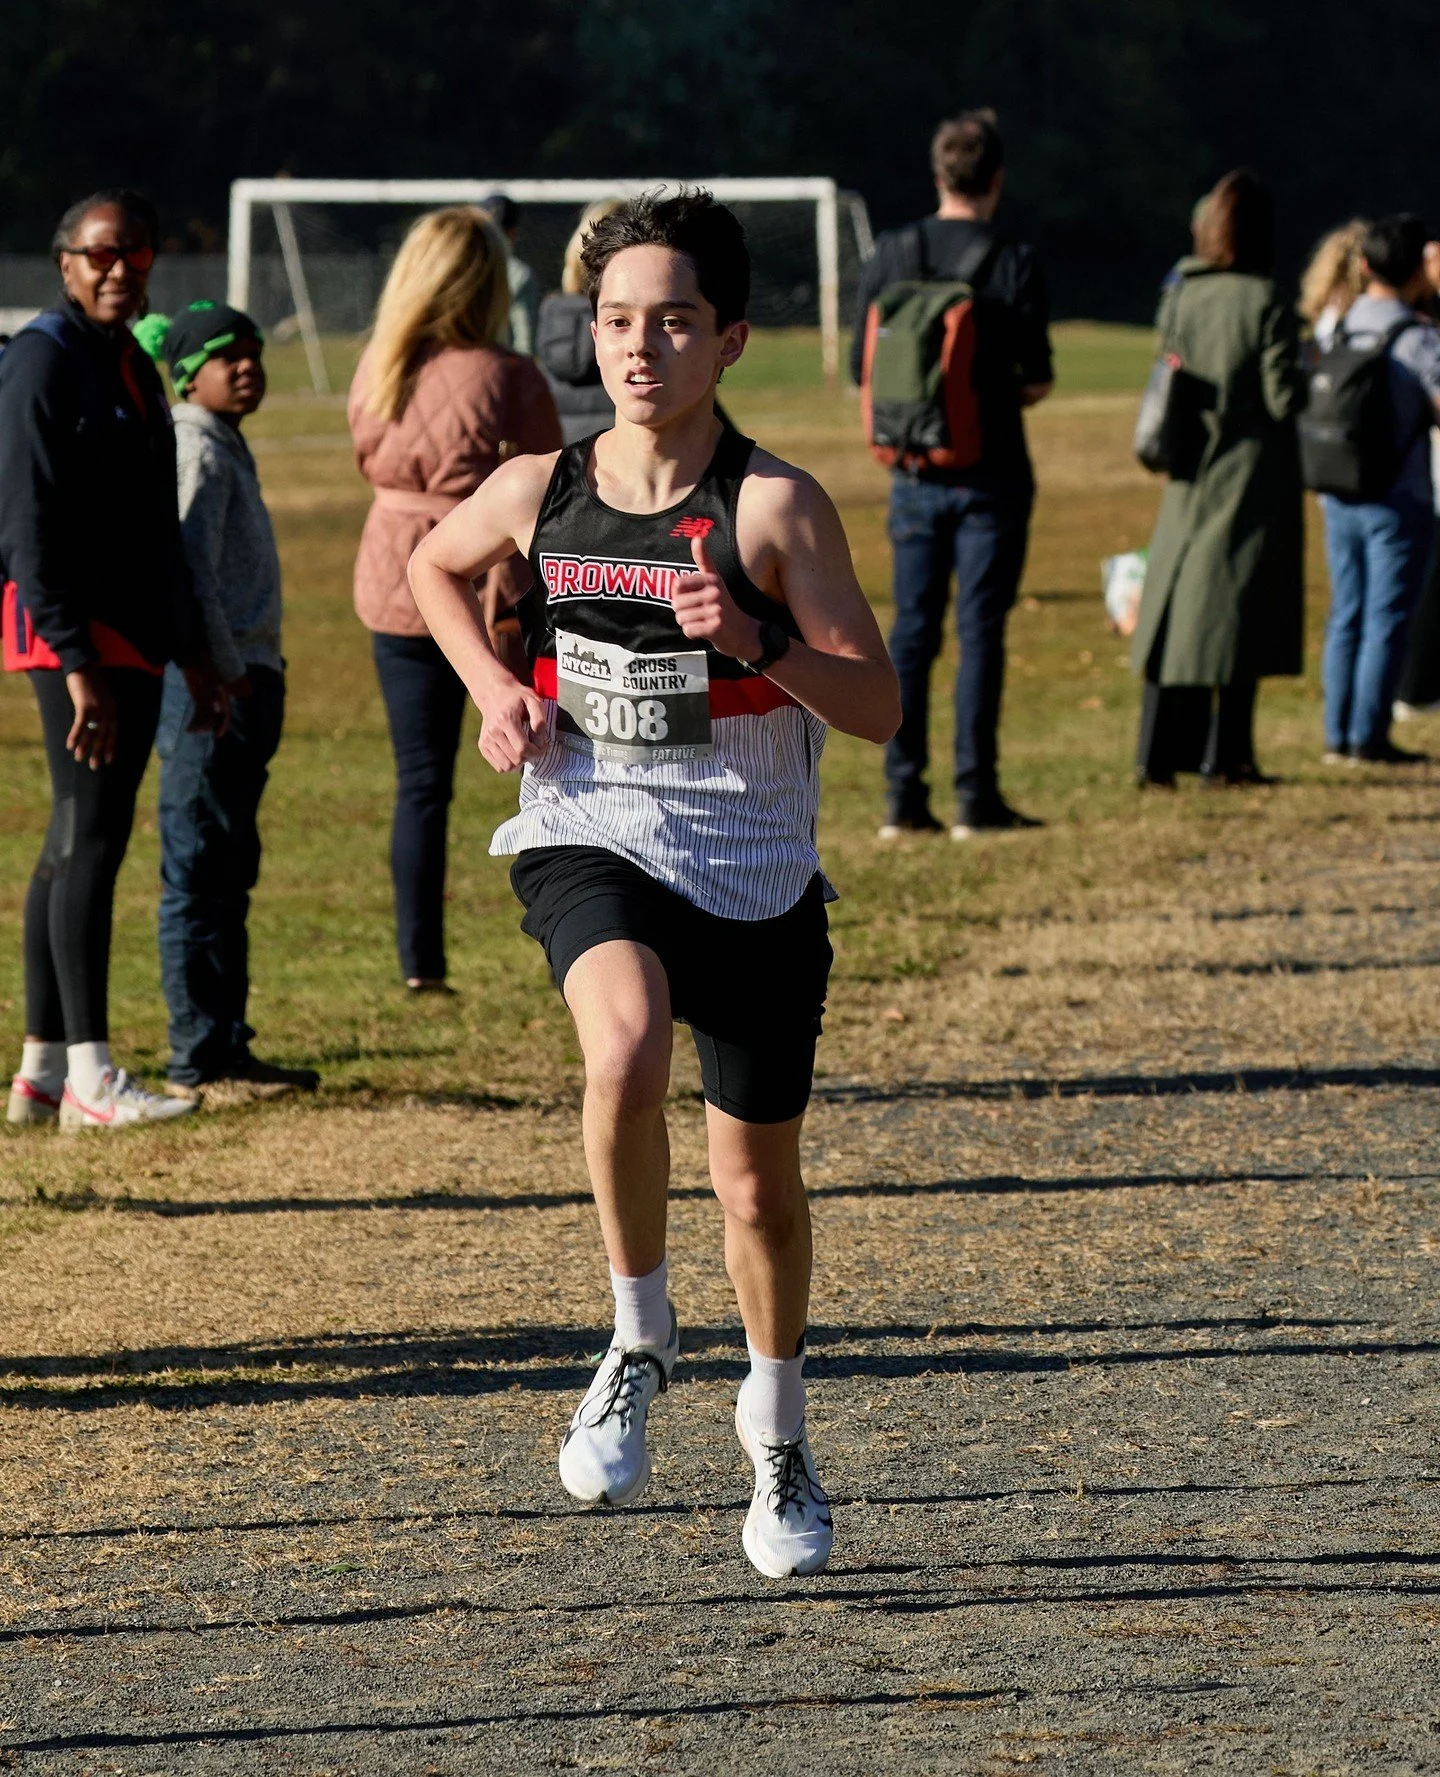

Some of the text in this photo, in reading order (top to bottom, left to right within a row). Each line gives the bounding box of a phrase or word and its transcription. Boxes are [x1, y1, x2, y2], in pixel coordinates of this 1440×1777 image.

[543, 558, 701, 602] BROWNI
[562, 656, 611, 681] NYCAL
[628, 658, 677, 674] CROSS
[623, 675, 687, 691] COUNTRY
[584, 691, 669, 741] 308
